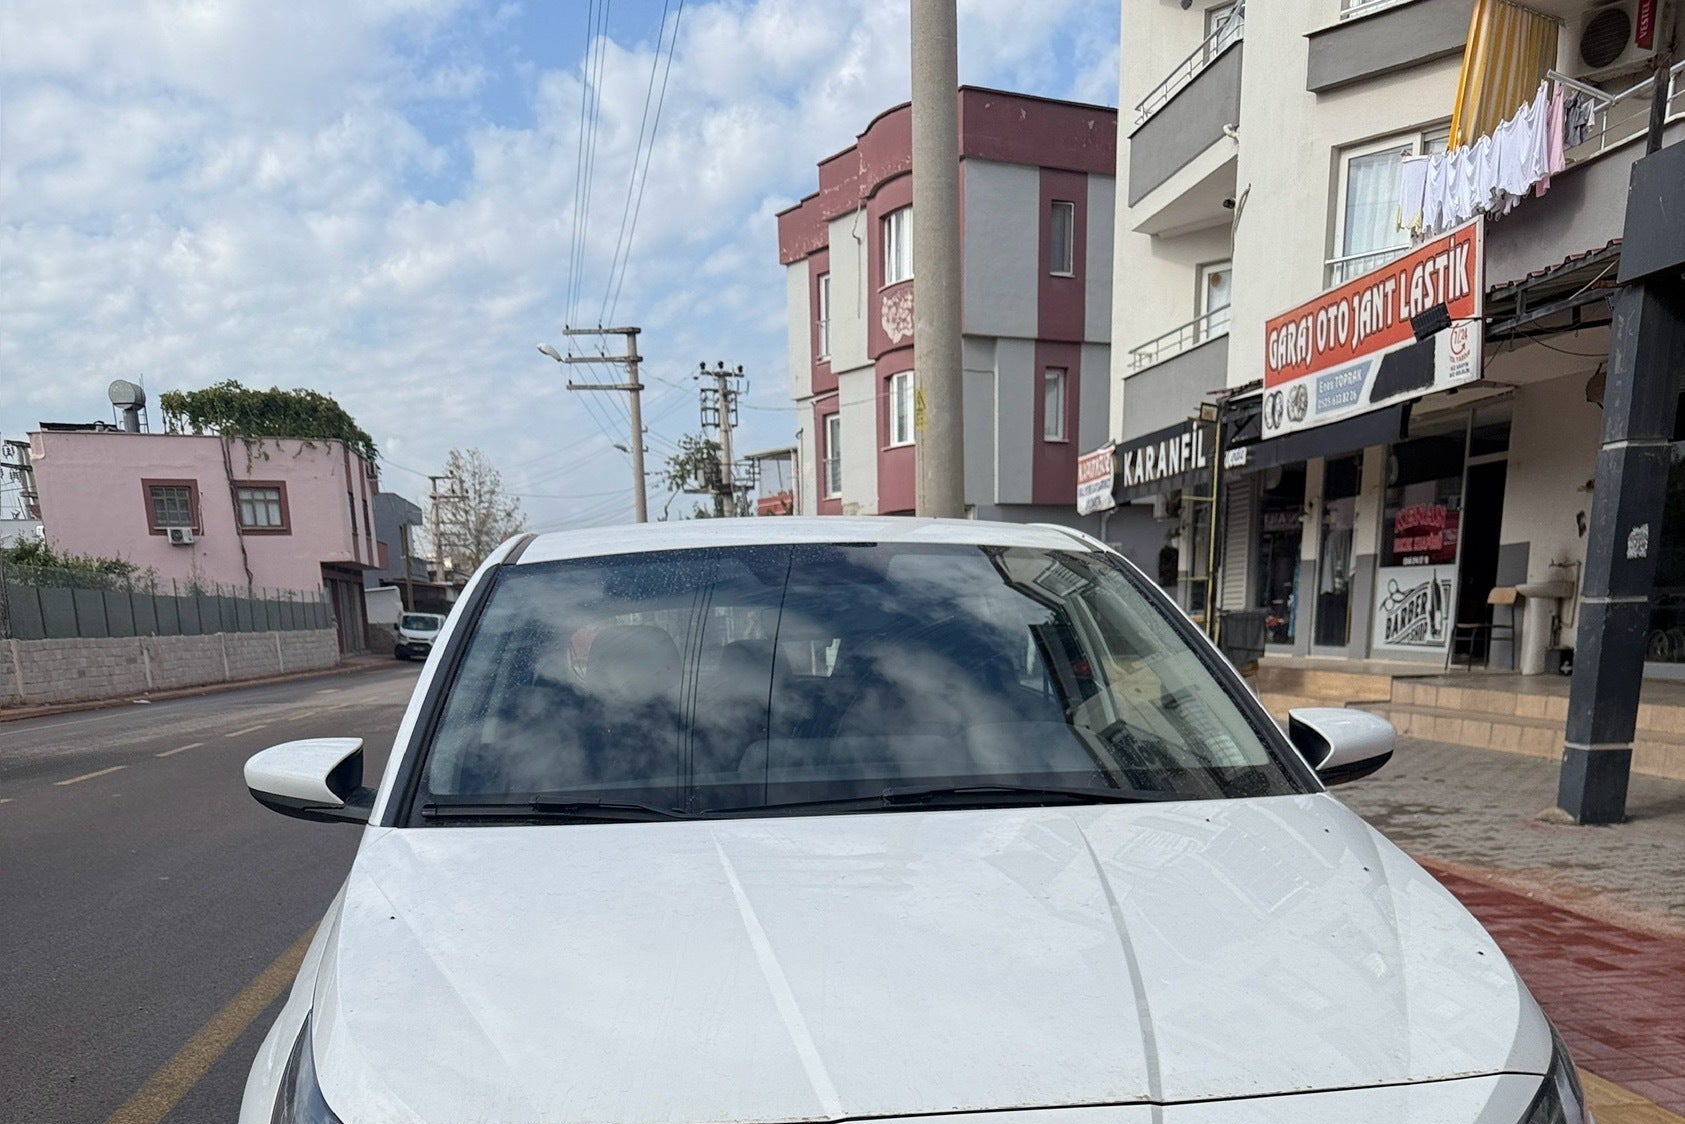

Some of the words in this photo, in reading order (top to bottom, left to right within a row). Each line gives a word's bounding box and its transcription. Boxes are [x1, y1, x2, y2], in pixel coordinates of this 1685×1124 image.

[1269, 313, 1313, 373] GARAJ
[1316, 297, 1349, 354] OTO
[1352, 275, 1396, 352] JANT
[1400, 234, 1470, 321] LASTİK
[1124, 421, 1206, 487] KARANFİL
[1385, 592, 1427, 640] BARBER
